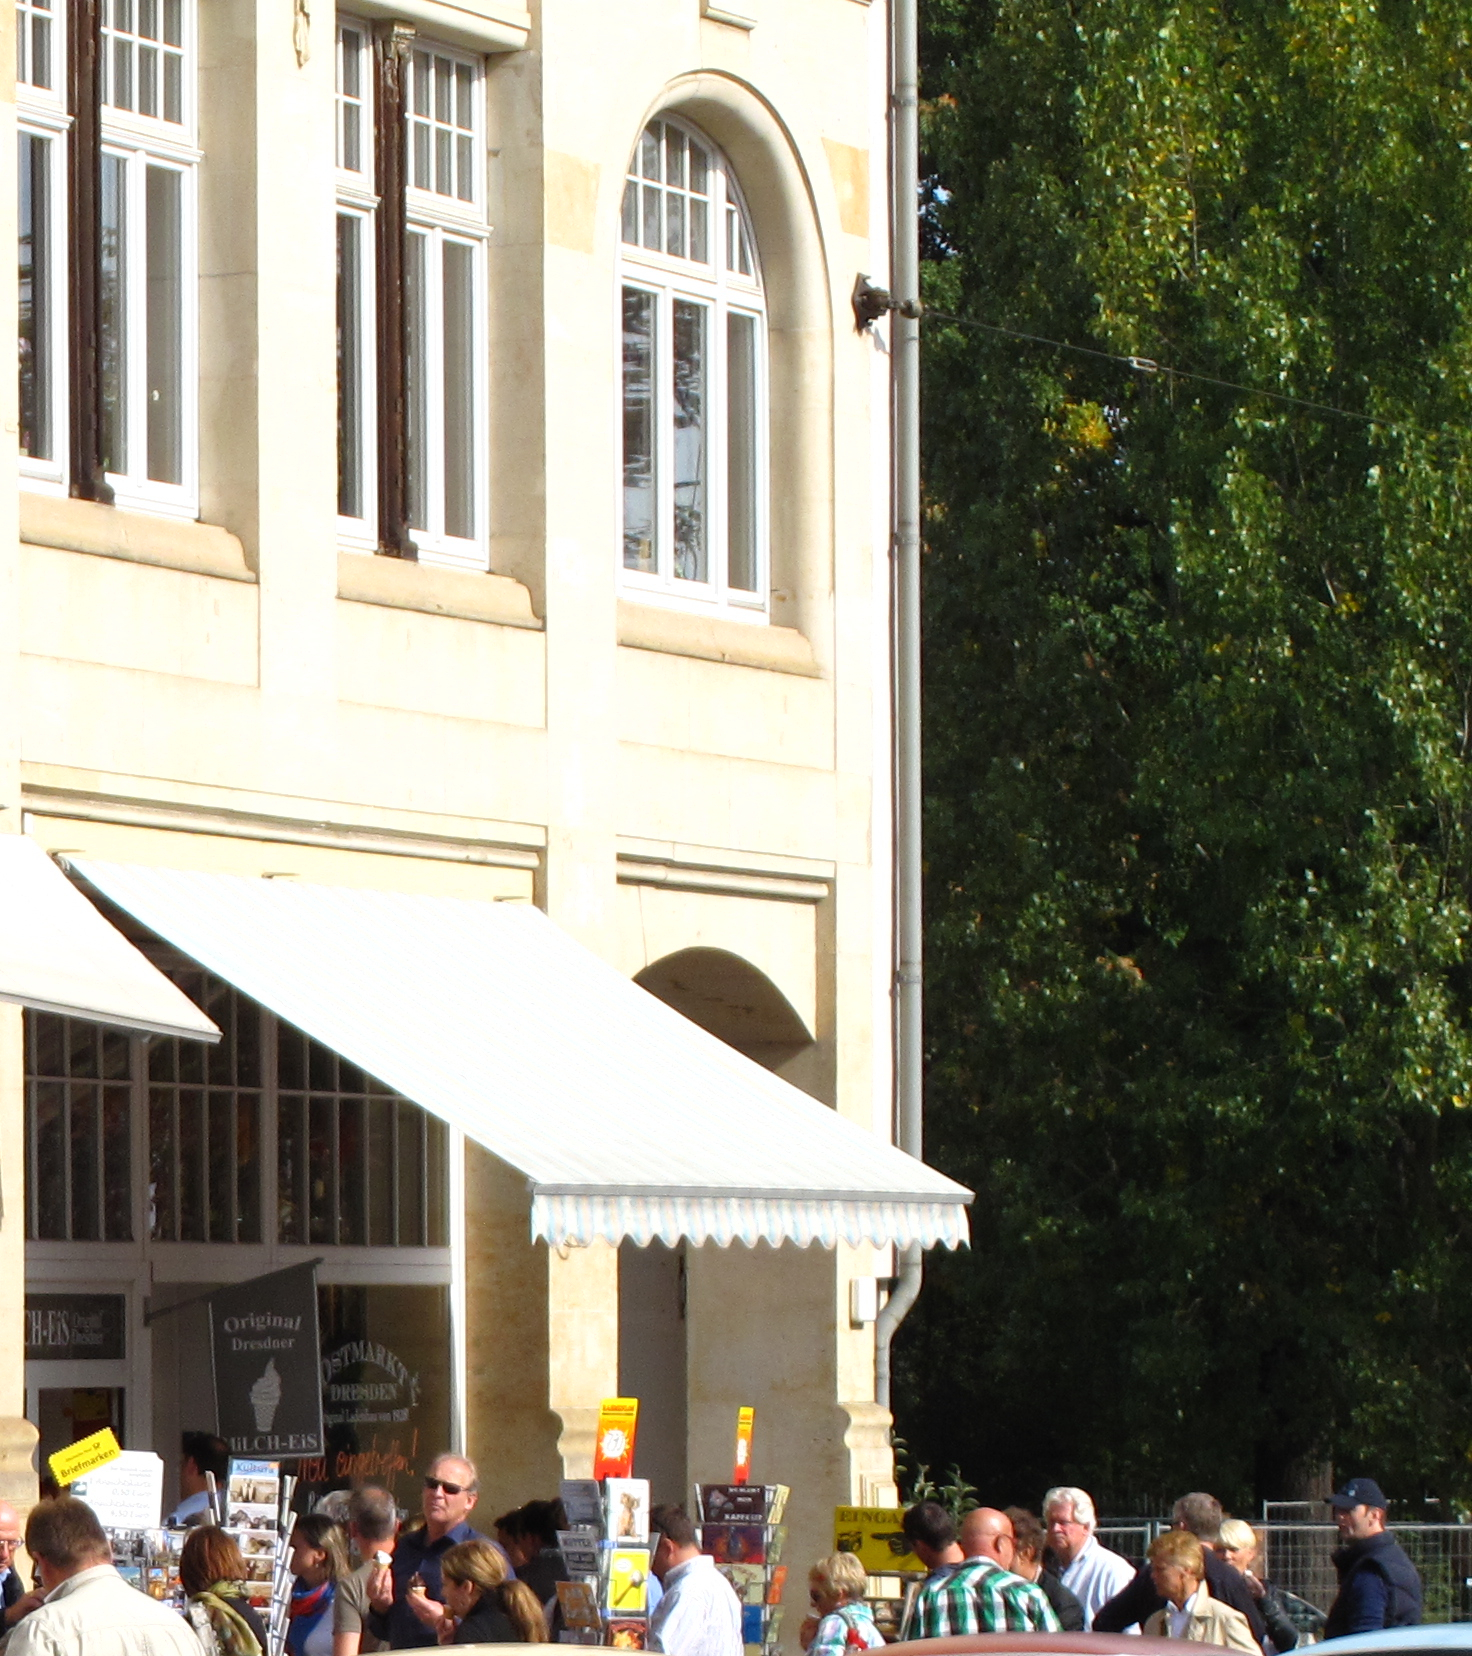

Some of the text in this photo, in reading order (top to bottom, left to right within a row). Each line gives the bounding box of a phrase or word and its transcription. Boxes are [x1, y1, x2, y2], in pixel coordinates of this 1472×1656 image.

[224, 1311, 303, 1333] Original
[232, 1337, 295, 1351] Dresdner
[331, 1384, 397, 1401] DRESDEN
[60, 1448, 115, 1478] Briefmarken
